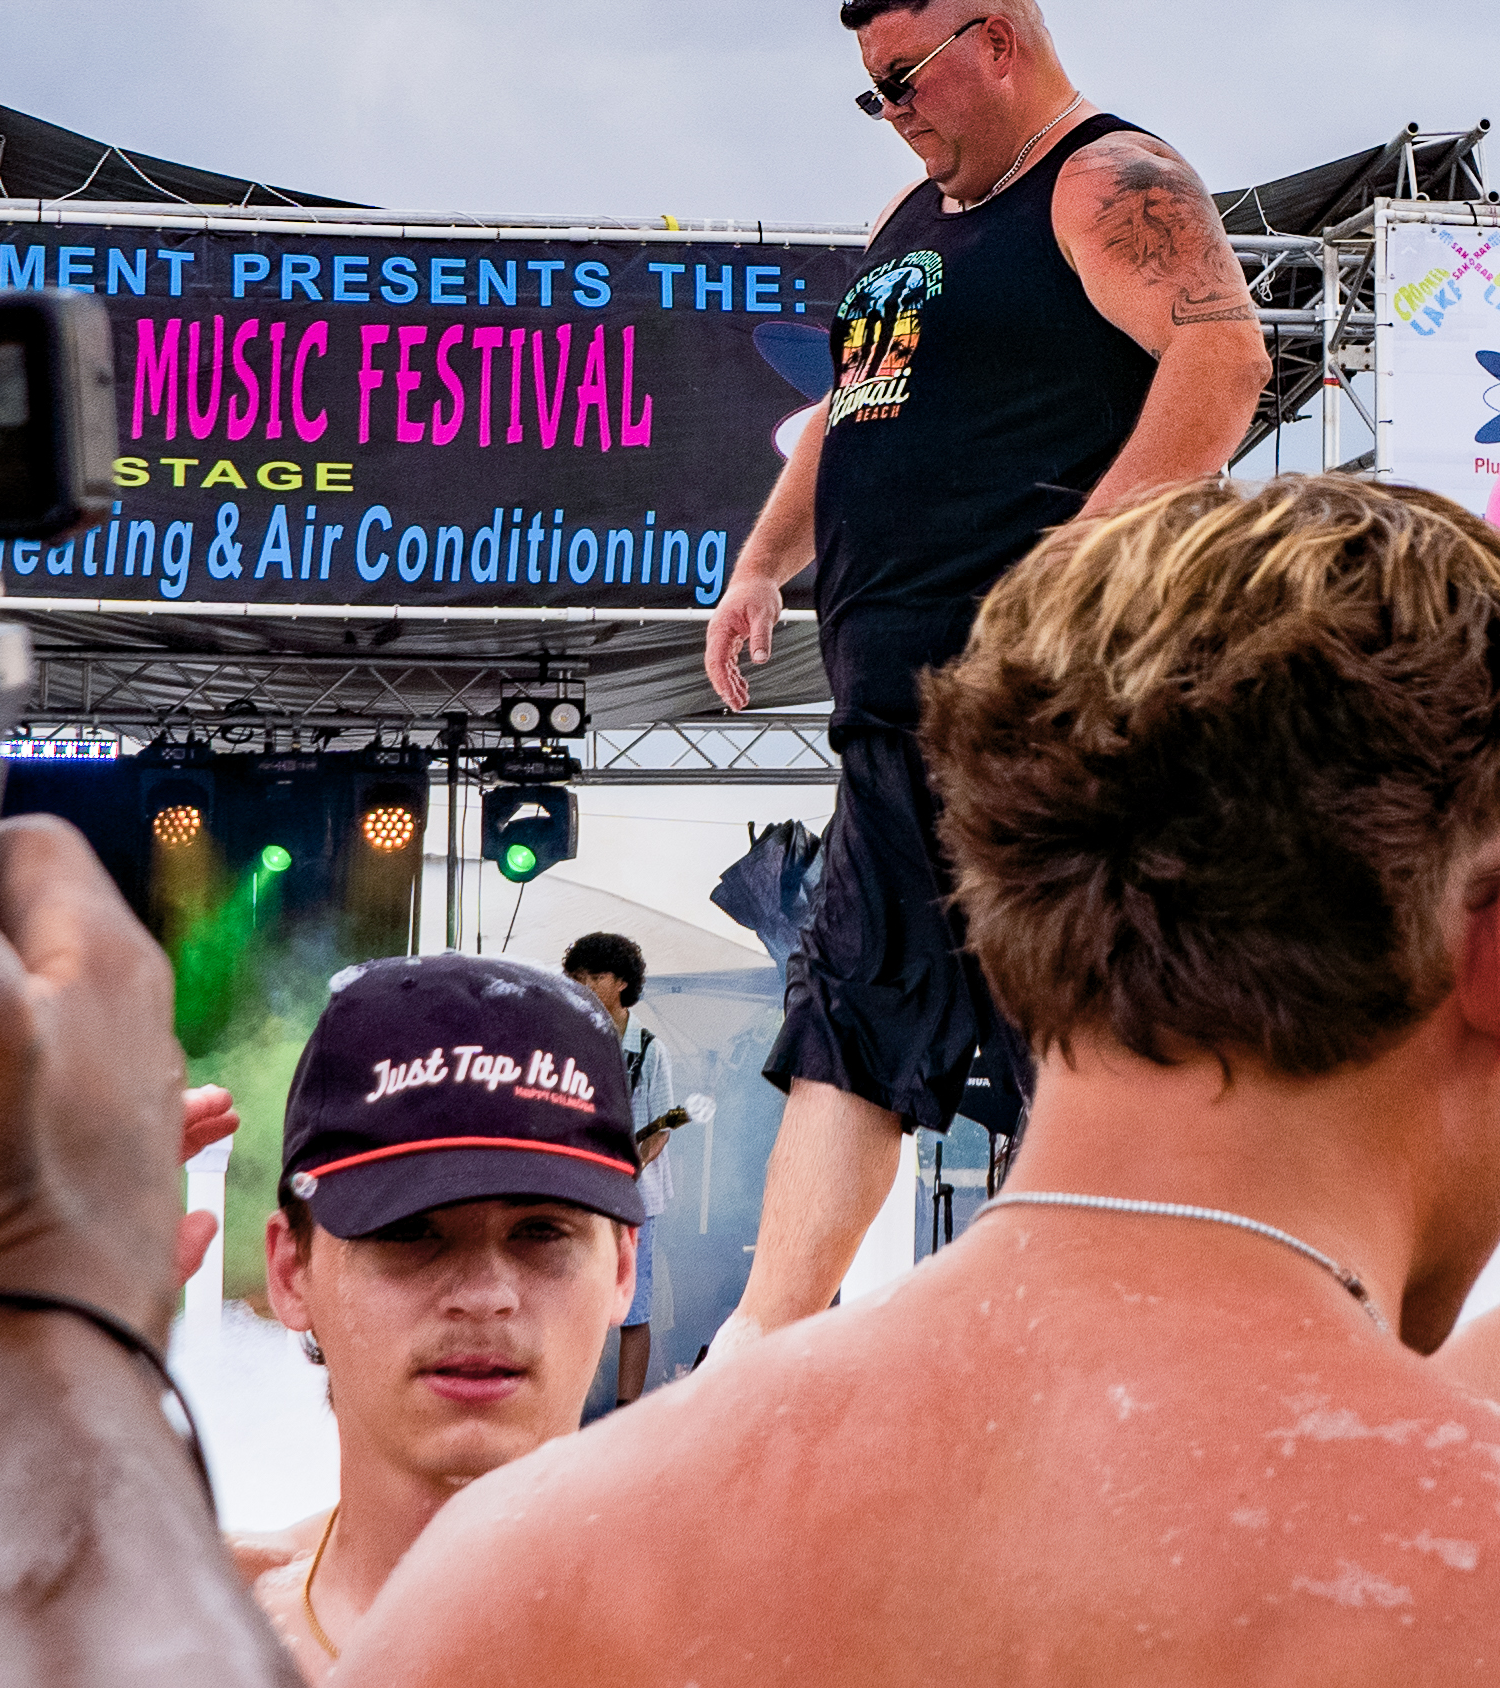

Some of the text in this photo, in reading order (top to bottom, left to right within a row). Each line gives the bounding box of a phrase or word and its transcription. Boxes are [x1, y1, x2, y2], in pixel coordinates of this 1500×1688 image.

[232, 253, 612, 308] PRESENTS
[647, 262, 806, 313] THE:
[837, 250, 944, 321] BEACH PARADISE
[1409, 279, 1462, 336] LAKE
[132, 314, 328, 442] MUSIC
[358, 323, 653, 452] FESTIVAL
[826, 367, 912, 435] Hawaii
[855, 404, 901, 423] BEACH
[113, 457, 354, 492] STAGE
[207, 501, 243, 580] &
[253, 504, 344, 580] Air
[355, 504, 727, 605] Conditioning
[365, 1045, 595, 1103] Just Tap It In
